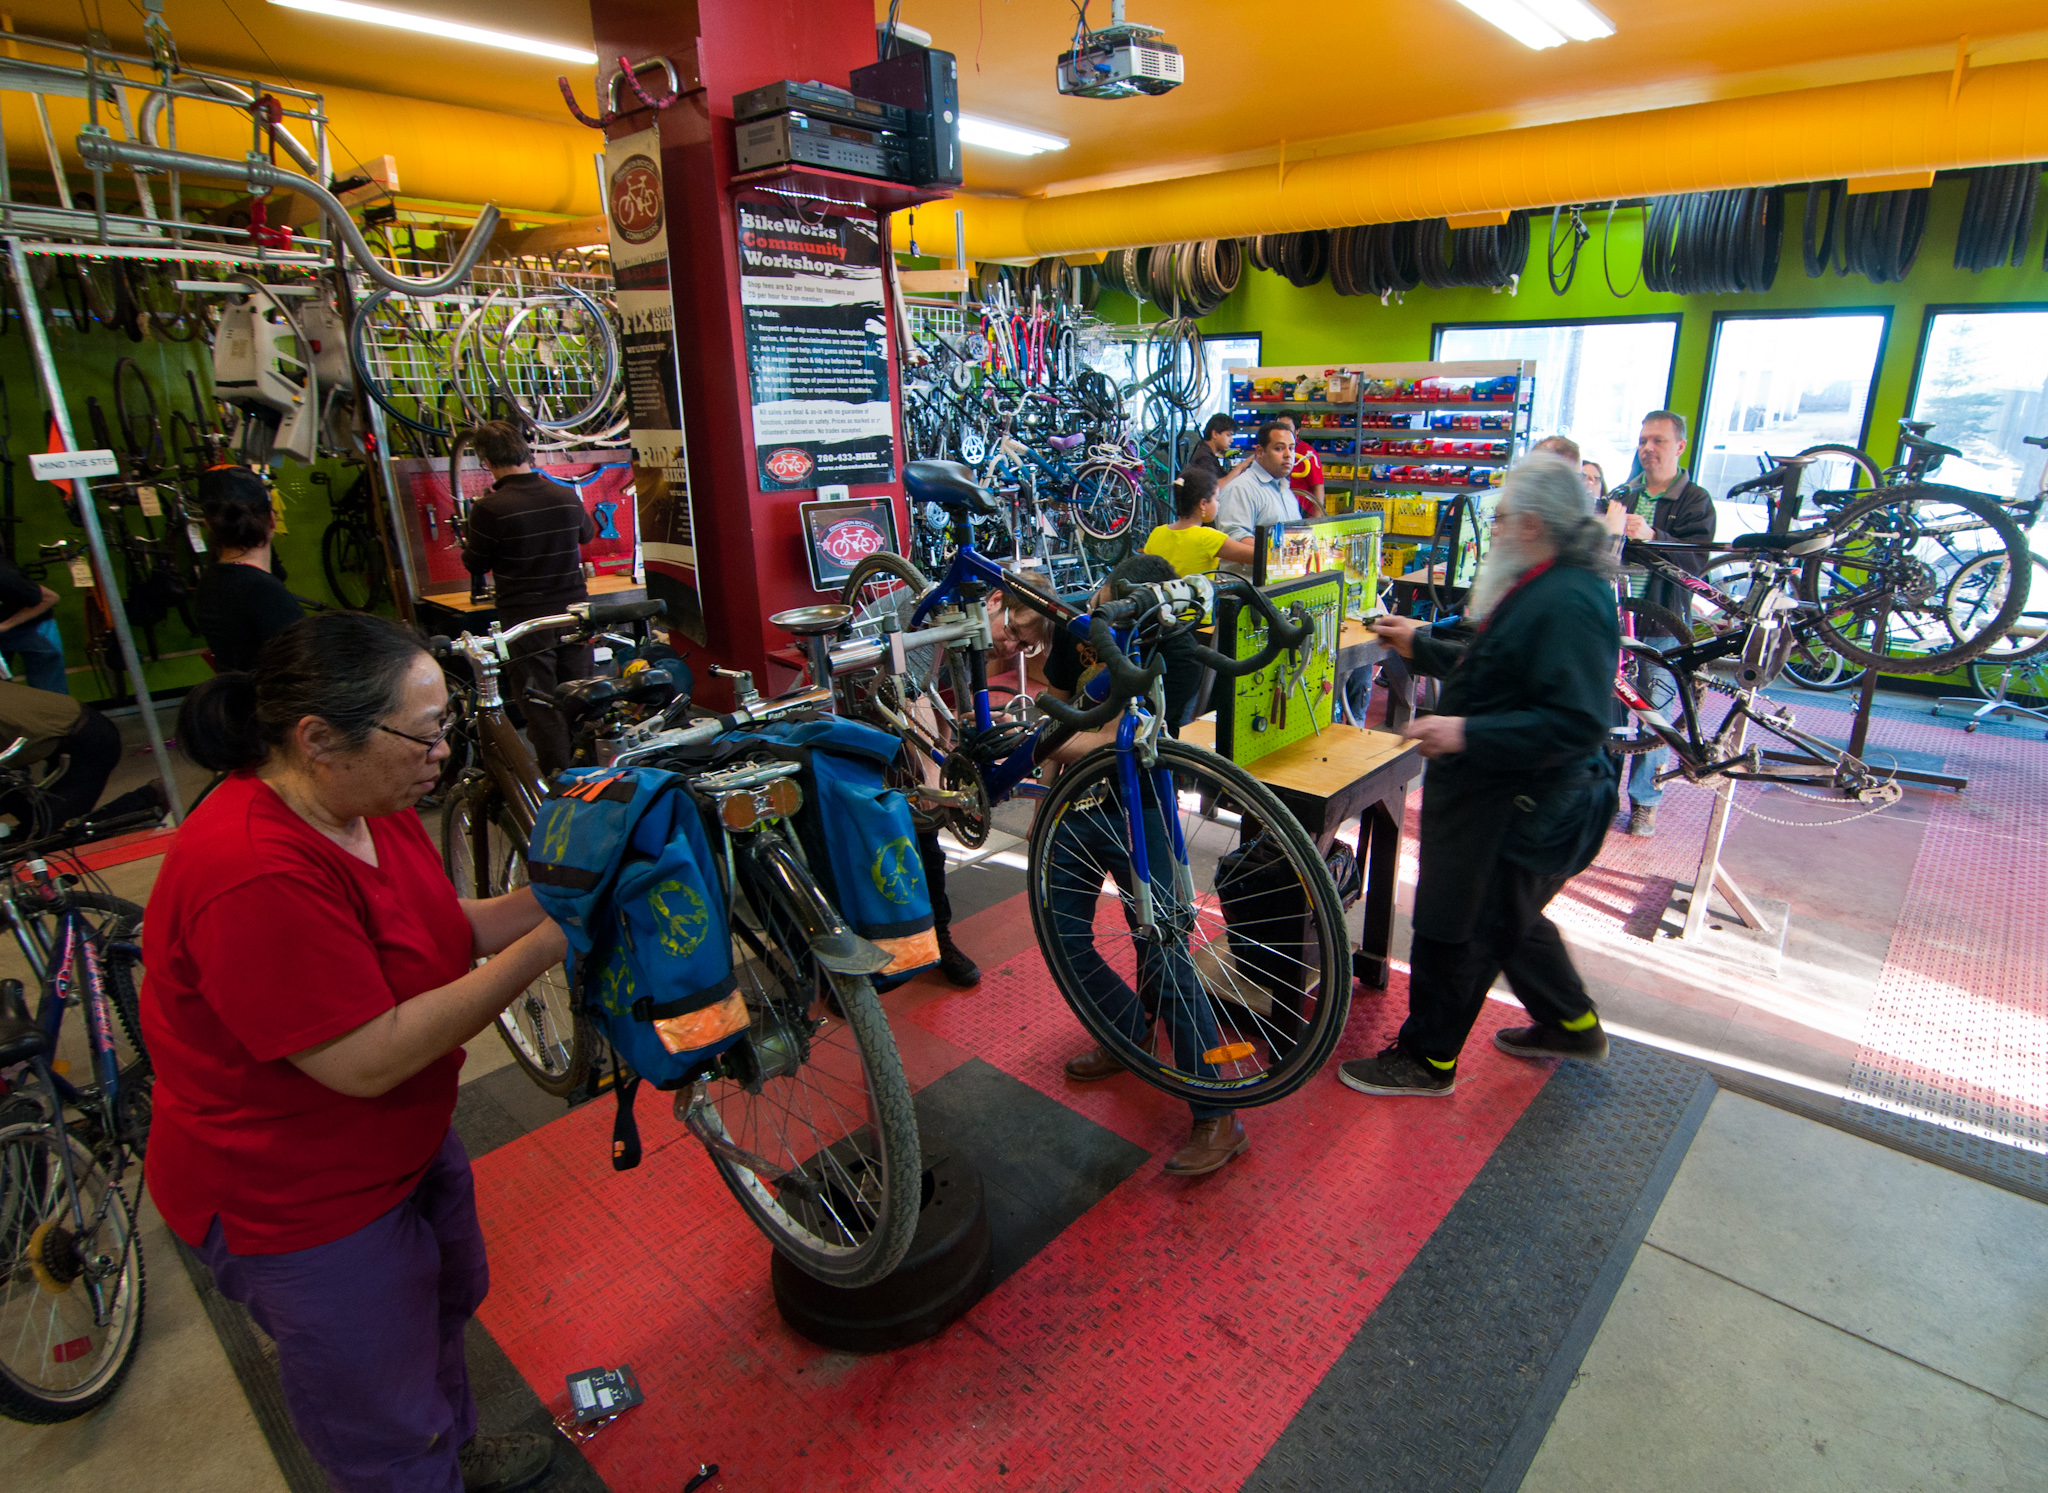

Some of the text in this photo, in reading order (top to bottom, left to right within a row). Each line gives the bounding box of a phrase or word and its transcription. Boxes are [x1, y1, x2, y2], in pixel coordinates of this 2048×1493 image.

[626, 223, 659, 240] COMMUTERS
[741, 213, 837, 239] BikeWorks
[743, 232, 847, 260] Community
[744, 250, 836, 276] Workshop
[748, 281, 761, 289] Shop
[763, 282, 774, 290] fees
[825, 287, 845, 296] members
[757, 292, 766, 300] per
[749, 309, 763, 318] Shop
[621, 310, 652, 335] FIX
[758, 324, 779, 332] Respect
[794, 326, 806, 334] shop
[799, 336, 832, 344] discrimination
[638, 447, 678, 467] RIDE
[817, 452, 877, 463] 780-433-BIKE
[39, 461, 65, 469] MIND
[91, 458, 115, 466] STEP
[817, 463, 888, 471] www.edmontonbikes.ca
[828, 520, 874, 532] EDMONTON BICYCLE
[768, 710, 787, 719] Park
[1187, 1075, 1257, 1089] VITESSE
